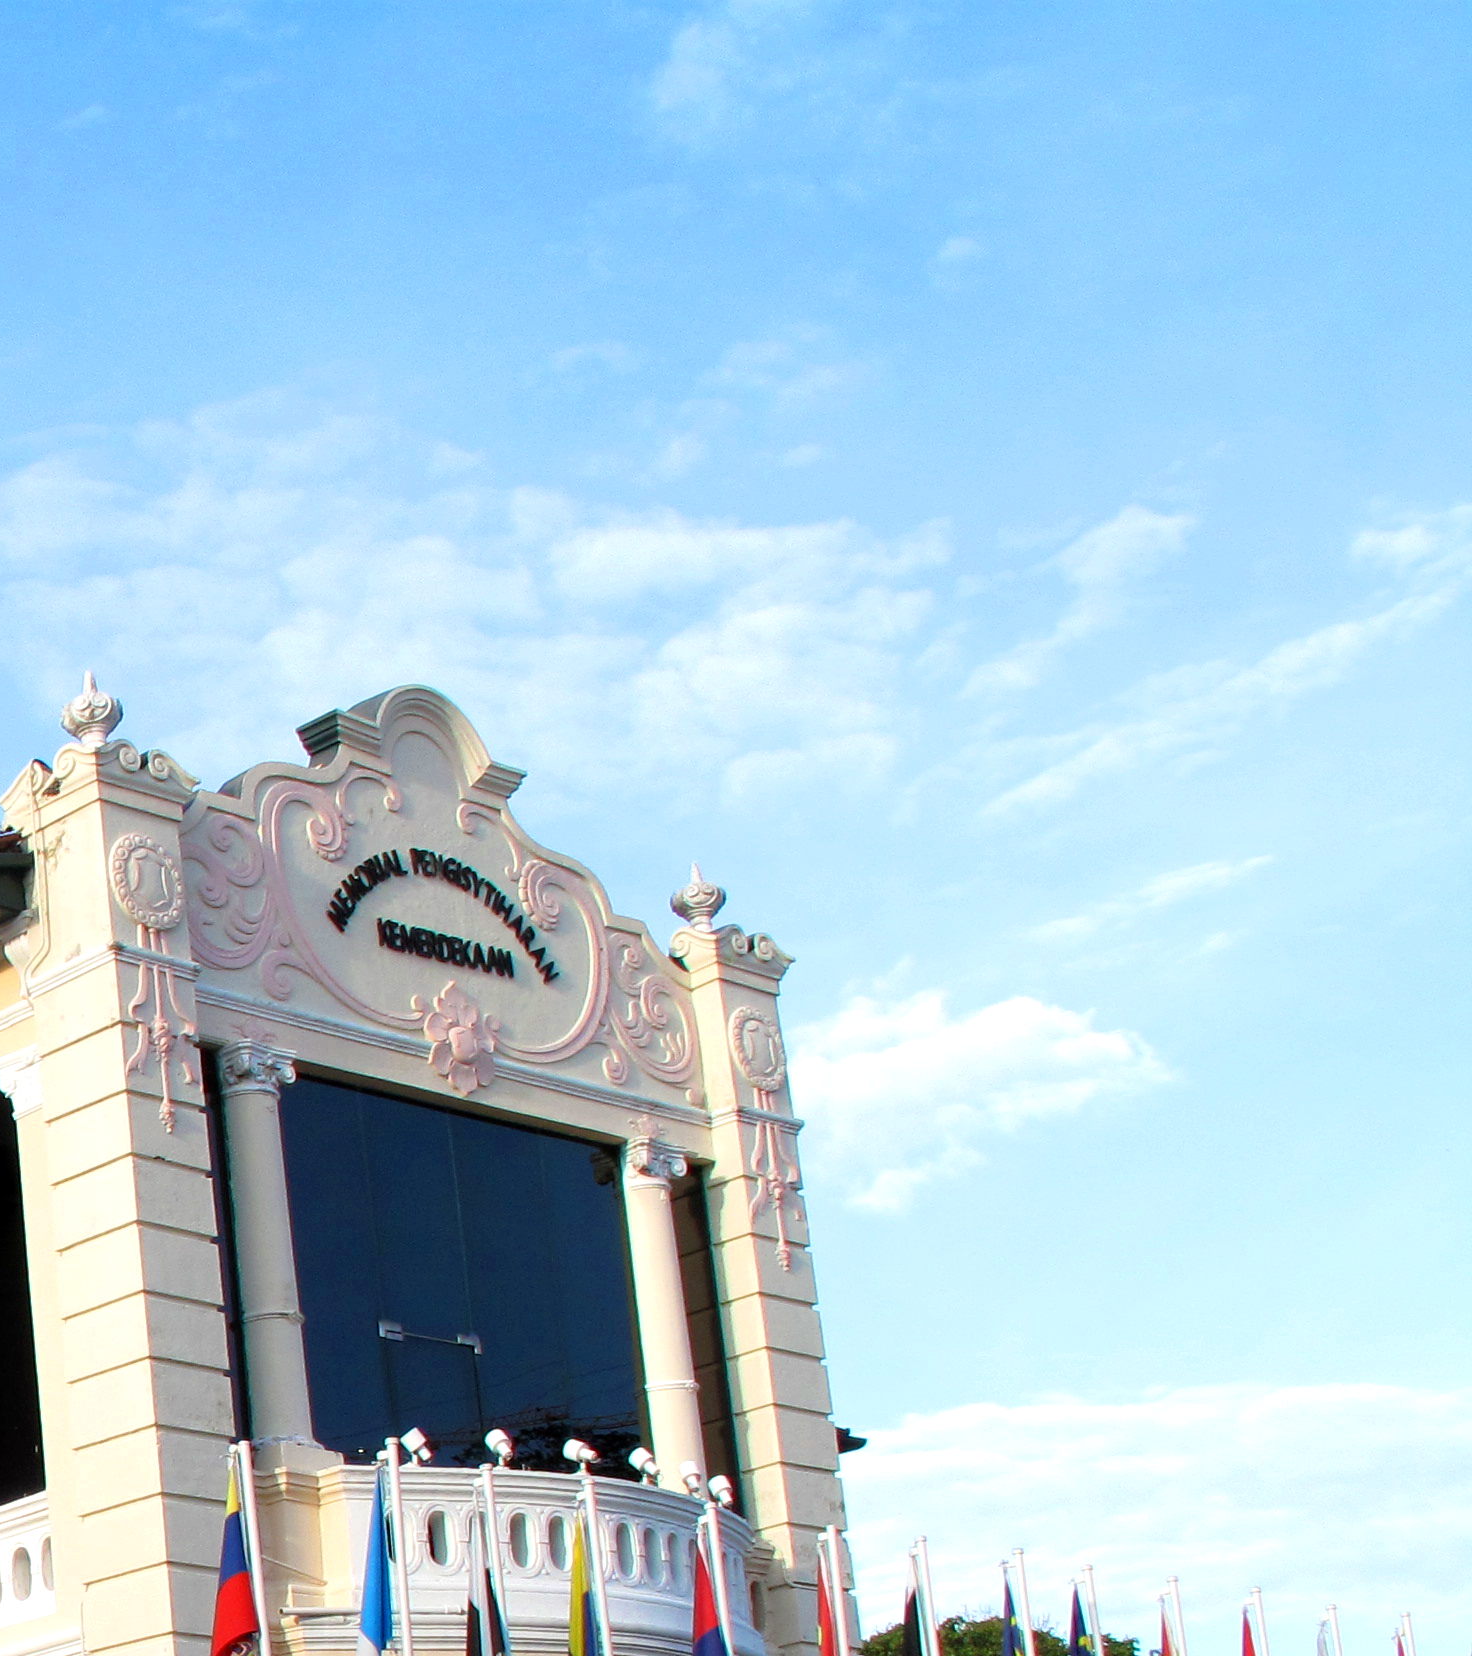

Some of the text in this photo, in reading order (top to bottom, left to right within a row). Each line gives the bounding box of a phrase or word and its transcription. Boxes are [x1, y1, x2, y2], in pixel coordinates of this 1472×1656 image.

[326, 848, 559, 985] MEMORIAL PENGISYTIHARAN
[377, 917, 515, 979] KEMERDEKAAN
